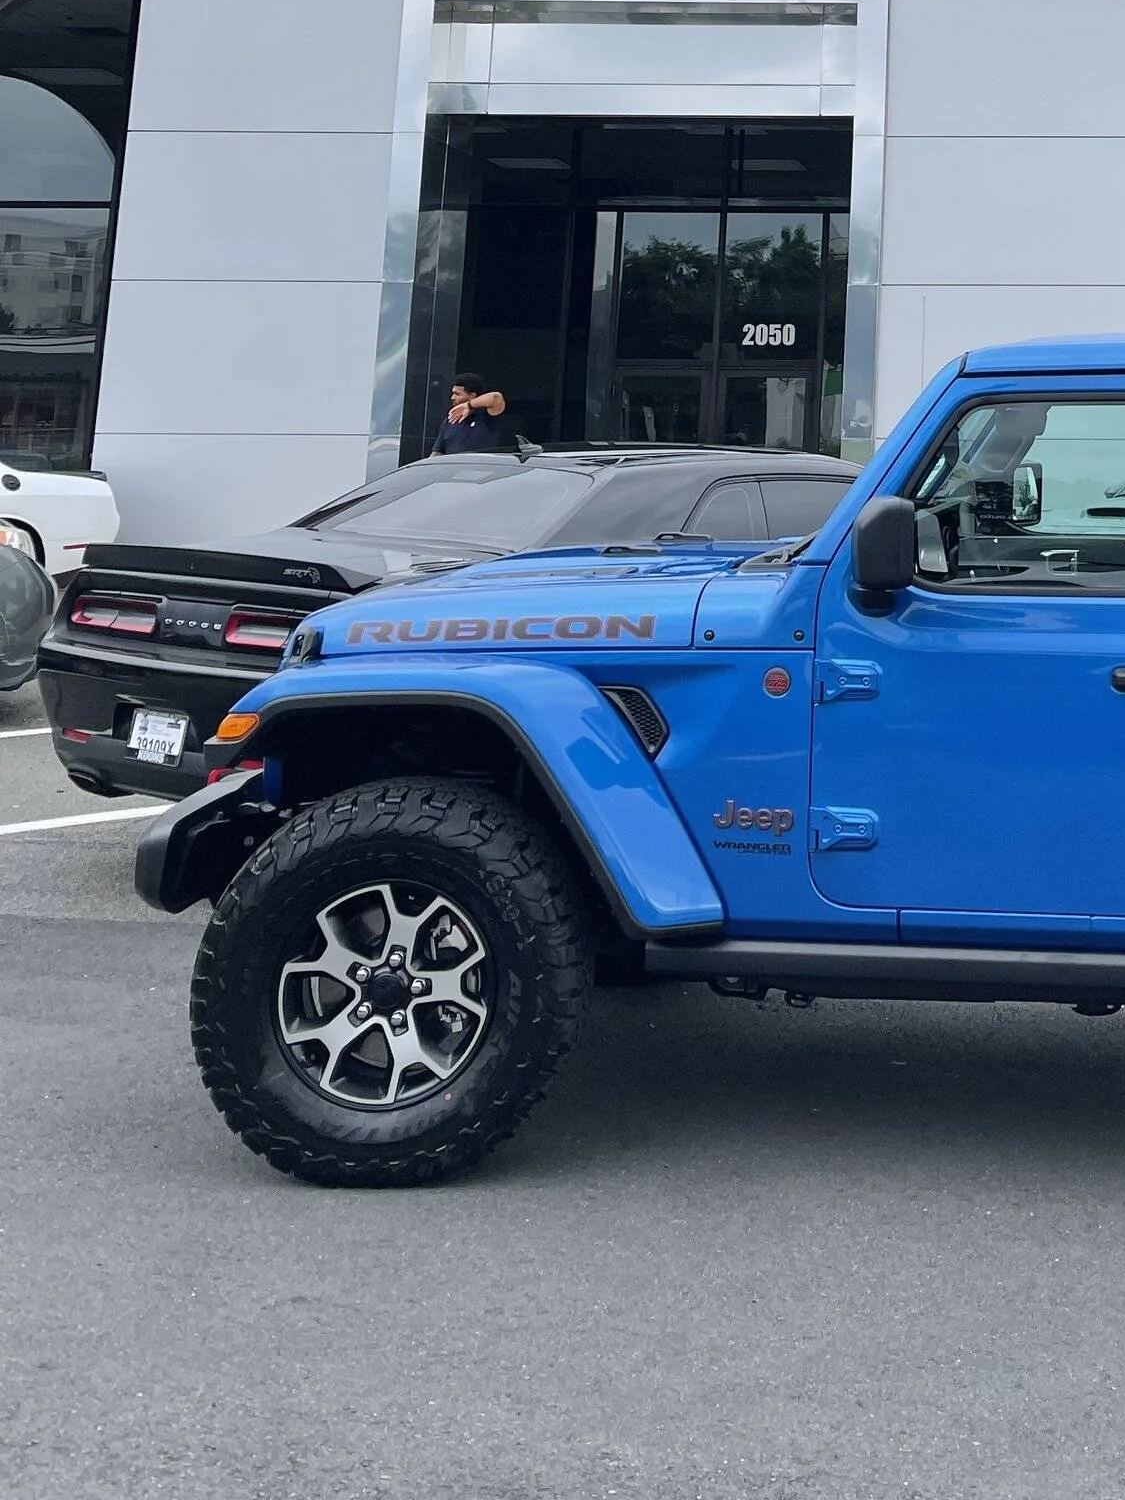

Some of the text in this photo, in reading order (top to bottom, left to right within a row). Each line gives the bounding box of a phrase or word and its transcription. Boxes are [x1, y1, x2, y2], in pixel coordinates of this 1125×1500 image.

[741, 323, 796, 346] 2050
[346, 614, 657, 645] RUBICON
[713, 799, 794, 837] Jeep
